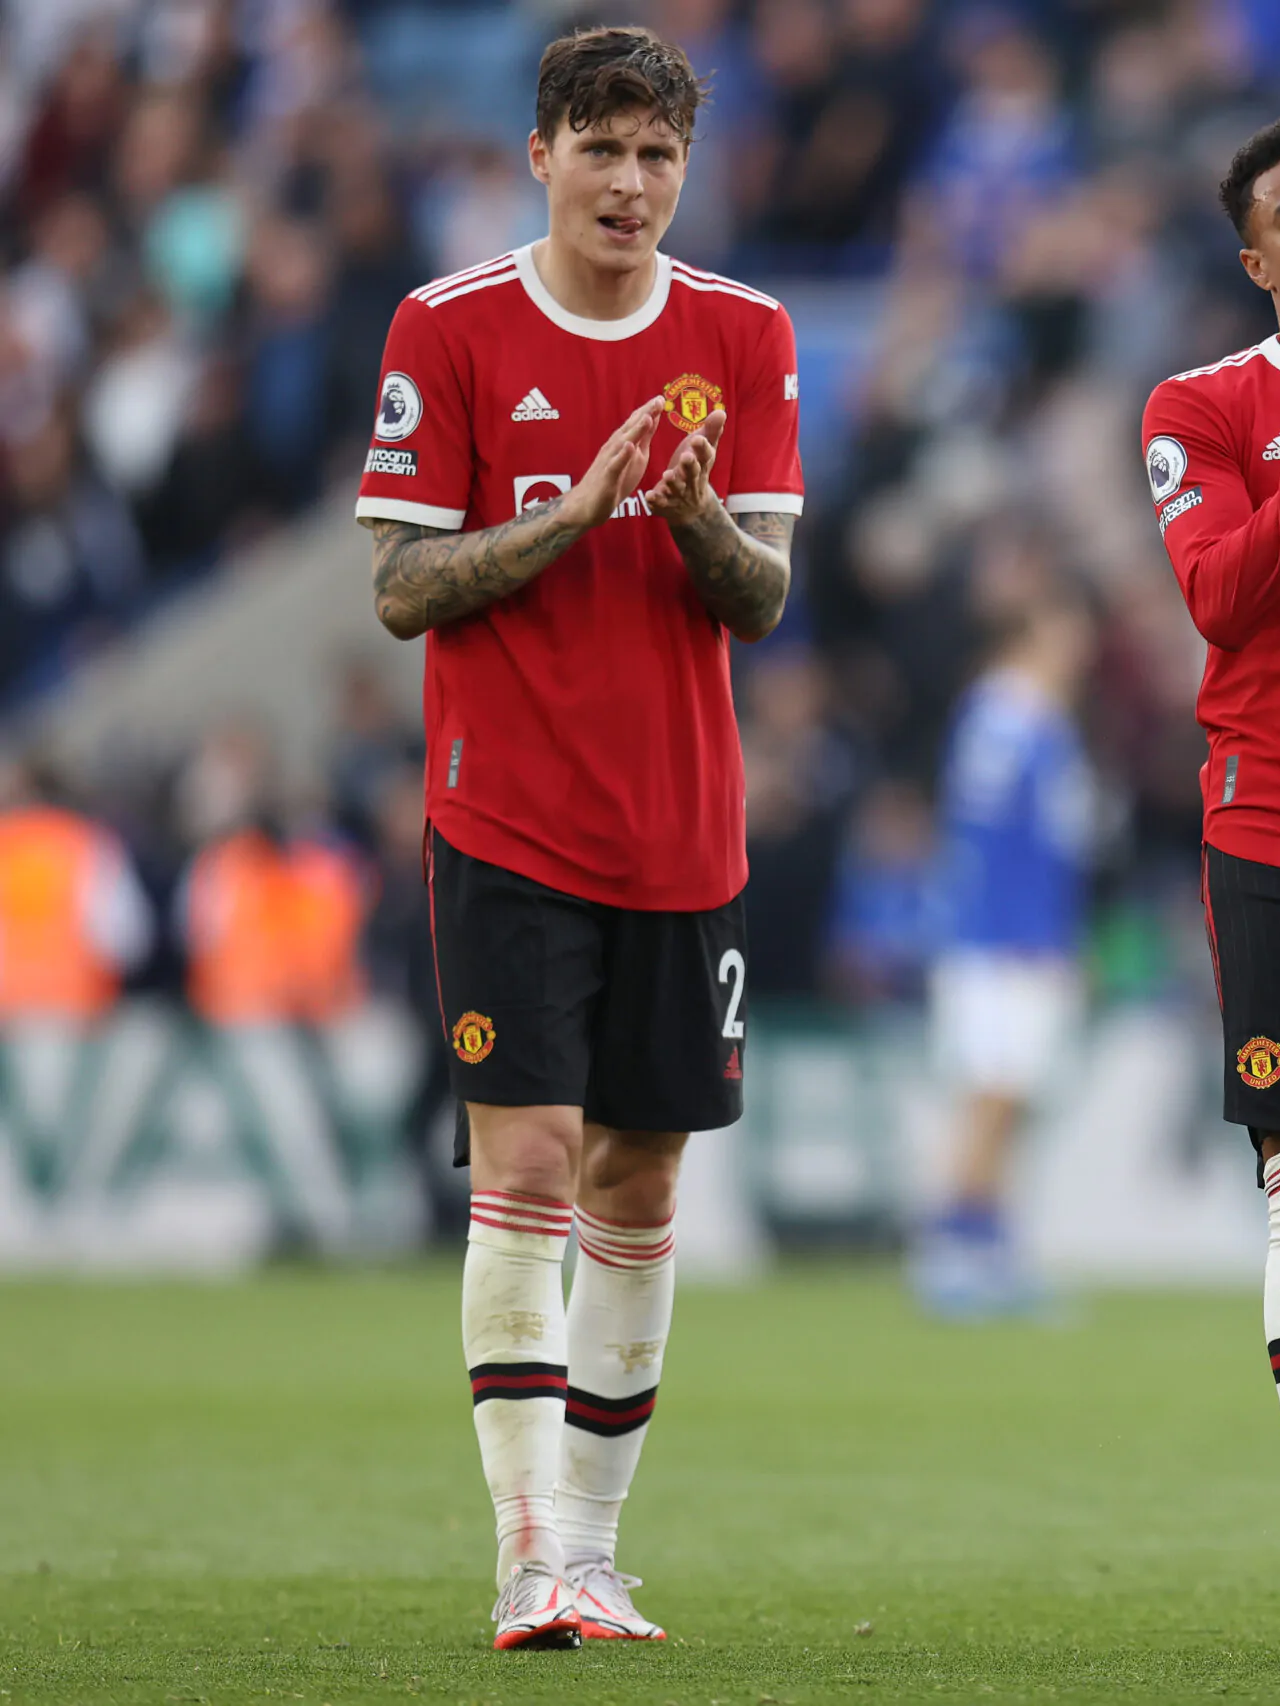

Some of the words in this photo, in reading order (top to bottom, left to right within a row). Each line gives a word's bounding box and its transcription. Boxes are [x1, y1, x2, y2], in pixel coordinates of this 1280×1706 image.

[511, 408, 560, 422] adidas
[374, 448, 413, 465] room
[371, 461, 417, 477] racism
[1163, 490, 1196, 517] room
[1165, 495, 1203, 527] racism
[718, 948, 746, 1039] 2
[1241, 1040, 1280, 1060] MANCHESTER
[1250, 1074, 1277, 1086] UNITED
